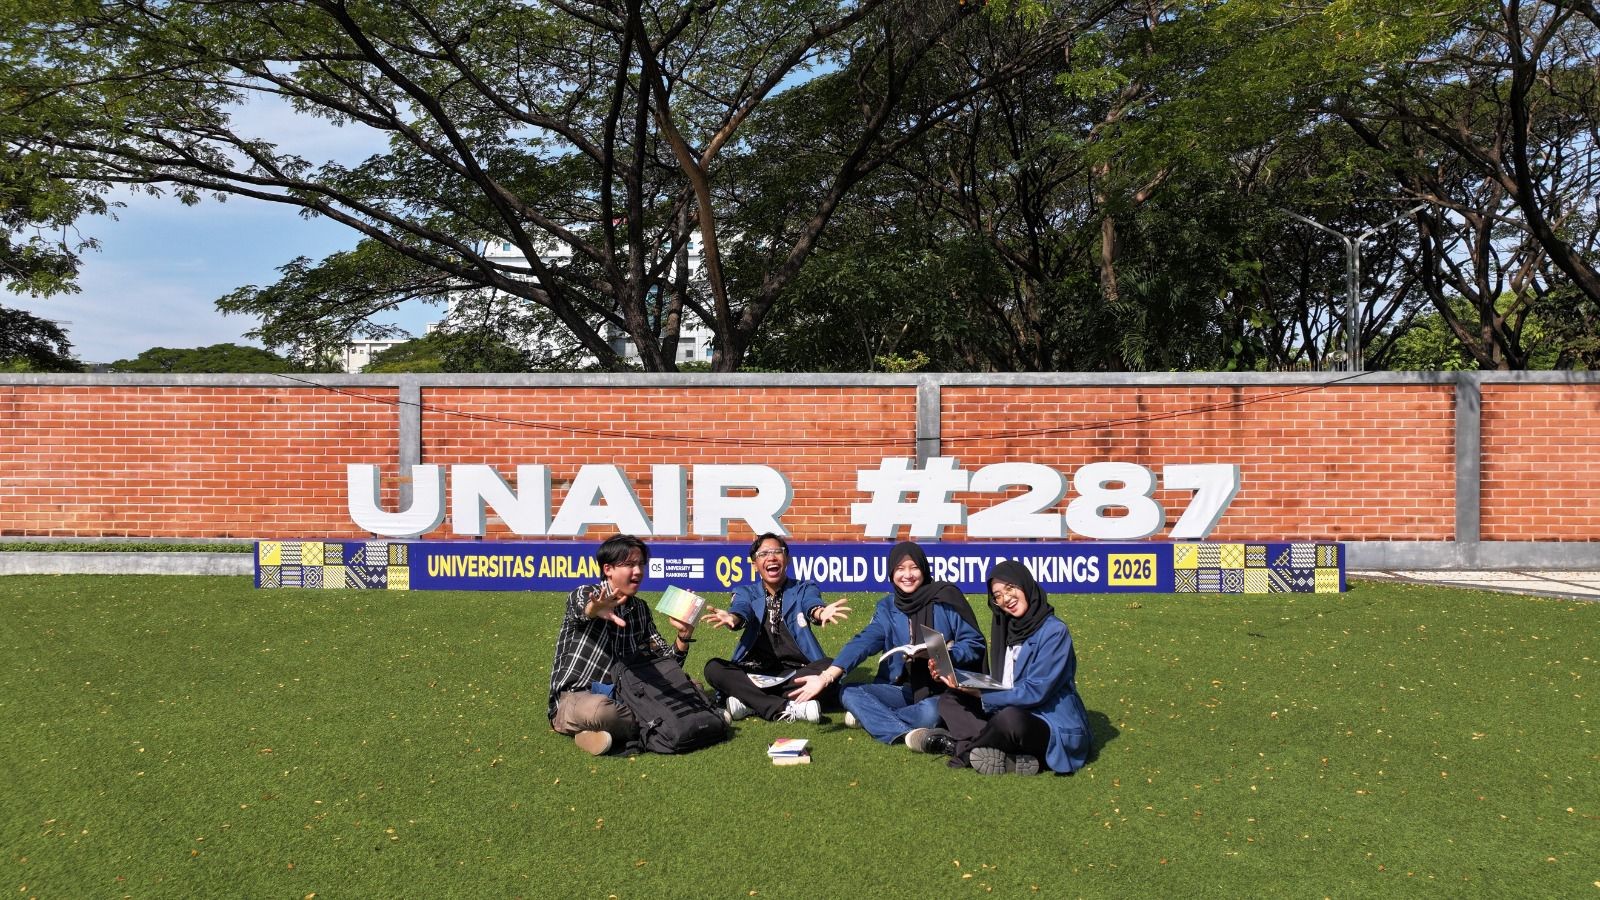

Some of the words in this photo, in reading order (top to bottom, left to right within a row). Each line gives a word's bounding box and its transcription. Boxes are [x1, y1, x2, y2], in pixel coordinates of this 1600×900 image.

[346, 464, 793, 536] UNAIR
[850, 456, 1239, 539] #287
[427, 555, 534, 578] UNIVERSITAS
[538, 555, 601, 578] AIRLAN
[651, 563, 662, 572] QS
[716, 555, 743, 588] QS
[792, 556, 868, 582] WORLD
[873, 556, 991, 583] URSITY
[995, 556, 1100, 583] NKINGS
[1113, 558, 1152, 579] 2026
